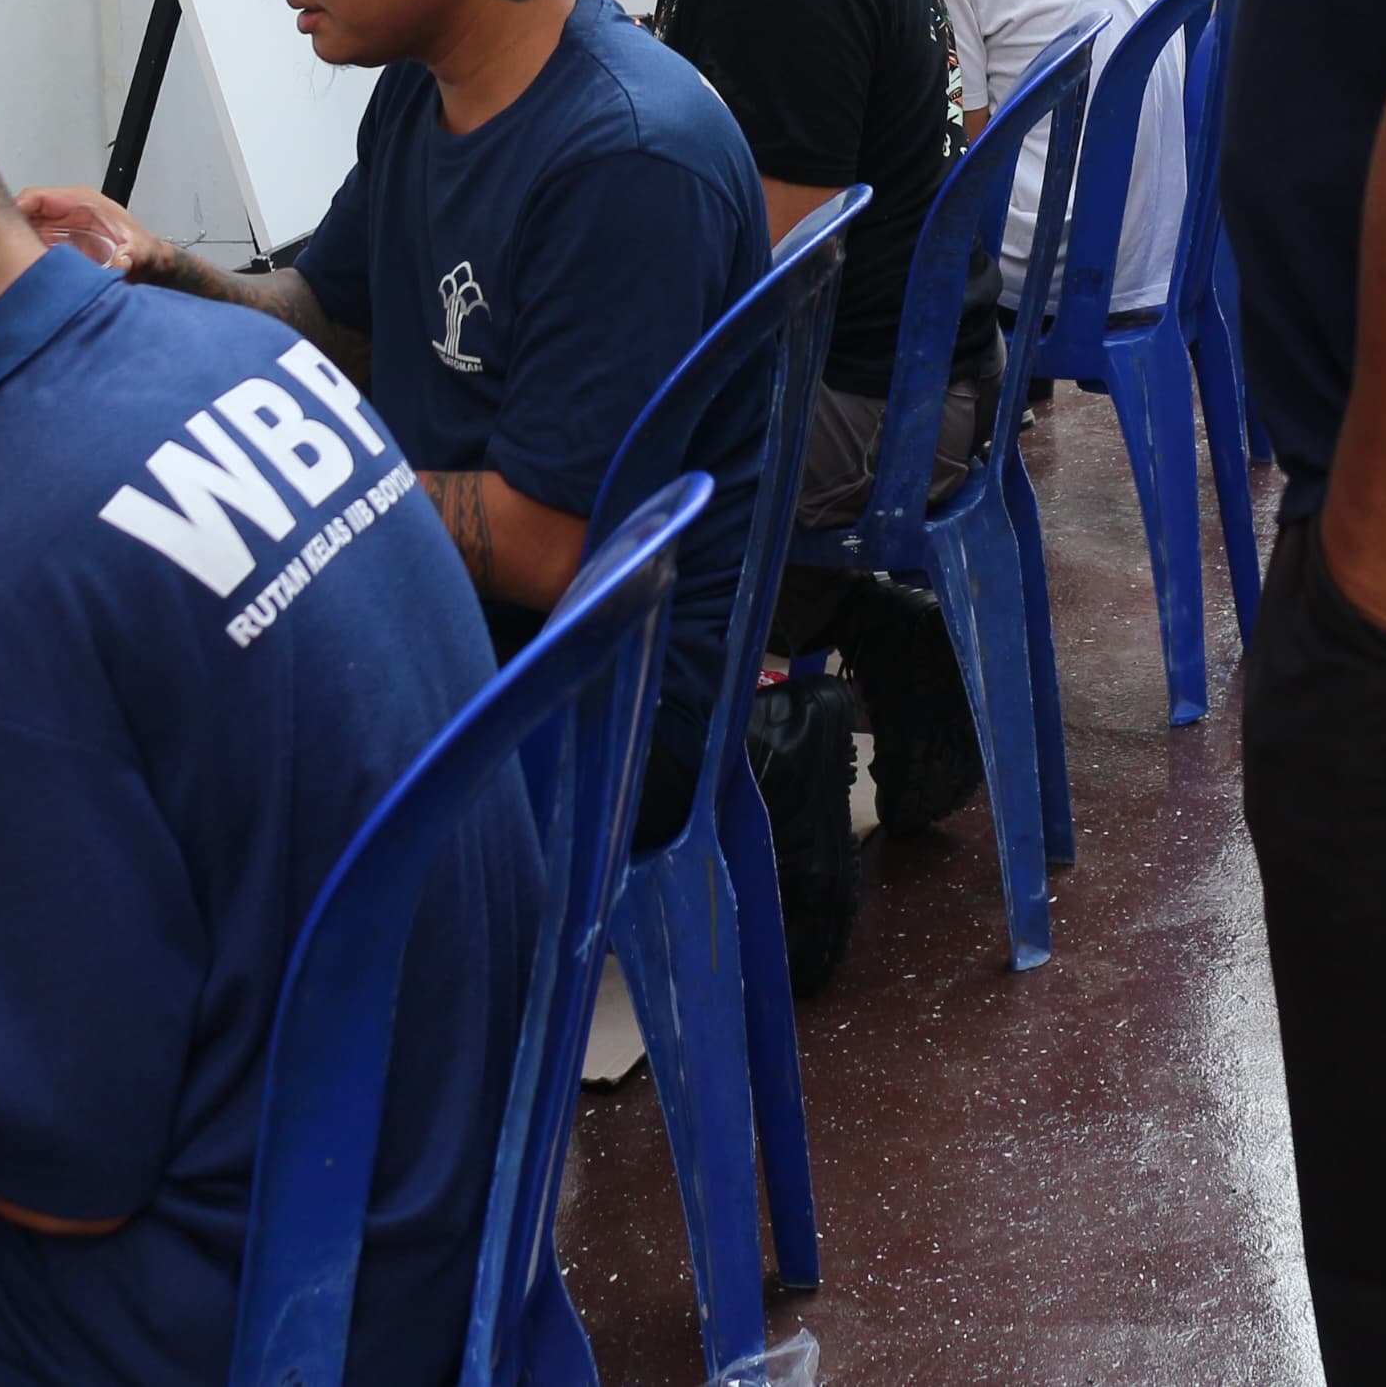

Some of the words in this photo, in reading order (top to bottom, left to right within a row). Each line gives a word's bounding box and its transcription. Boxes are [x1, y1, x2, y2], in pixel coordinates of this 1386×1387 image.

[97, 337, 387, 600] WBP
[224, 555, 313, 650] RUTAN
[299, 515, 354, 577] KELAS
